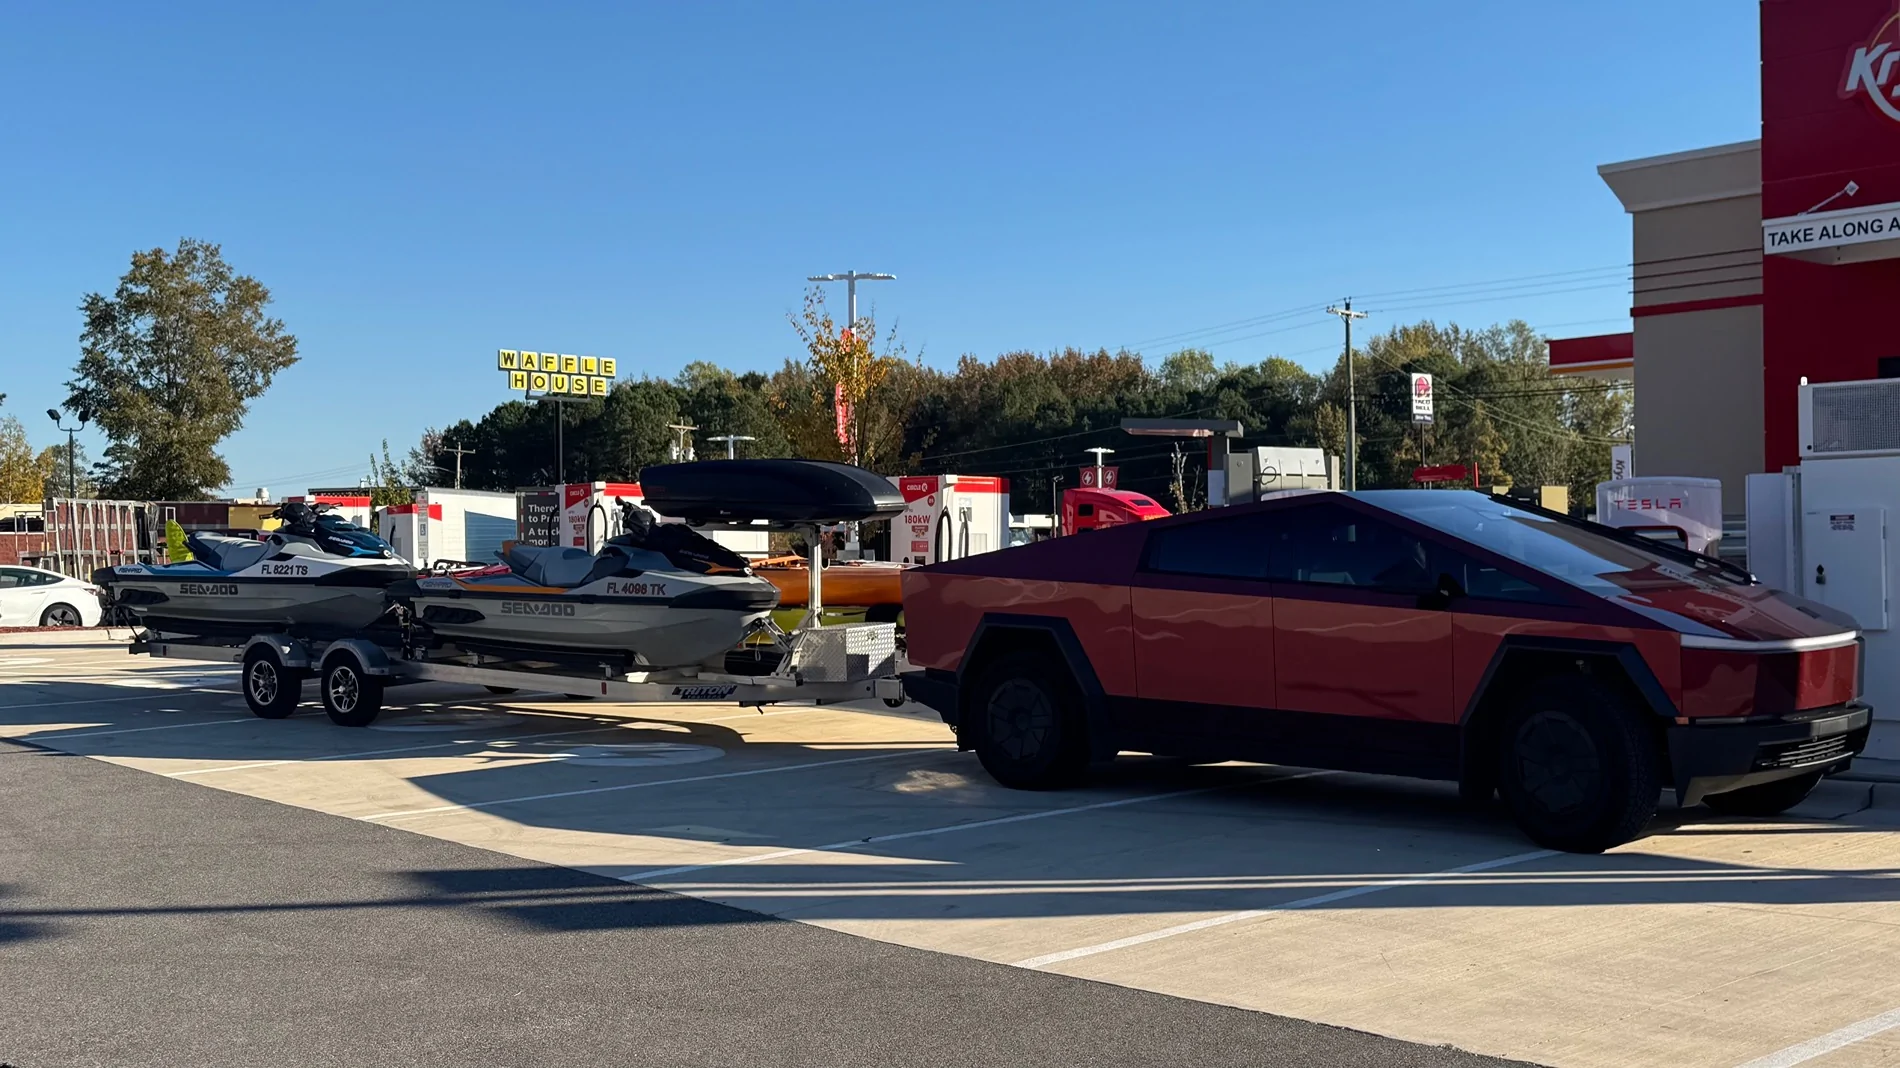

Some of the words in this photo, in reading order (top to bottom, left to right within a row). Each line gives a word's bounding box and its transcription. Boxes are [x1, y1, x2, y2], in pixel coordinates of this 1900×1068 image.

[1768, 228, 1814, 246] TAKE
[1819, 219, 1883, 240] ALONG
[502, 352, 613, 374] WAFFLE
[514, 373, 604, 393] HOUSE
[1614, 498, 1682, 510] TESLA
[528, 515, 539, 523] to
[904, 514, 931, 524] 180kW
[528, 527, 536, 536] A
[261, 564, 271, 574] FL
[273, 564, 294, 575] 8221
[295, 564, 308, 575] TS
[606, 582, 619, 594] FL
[650, 583, 667, 595] TK
[680, 686, 731, 695] TRITON
